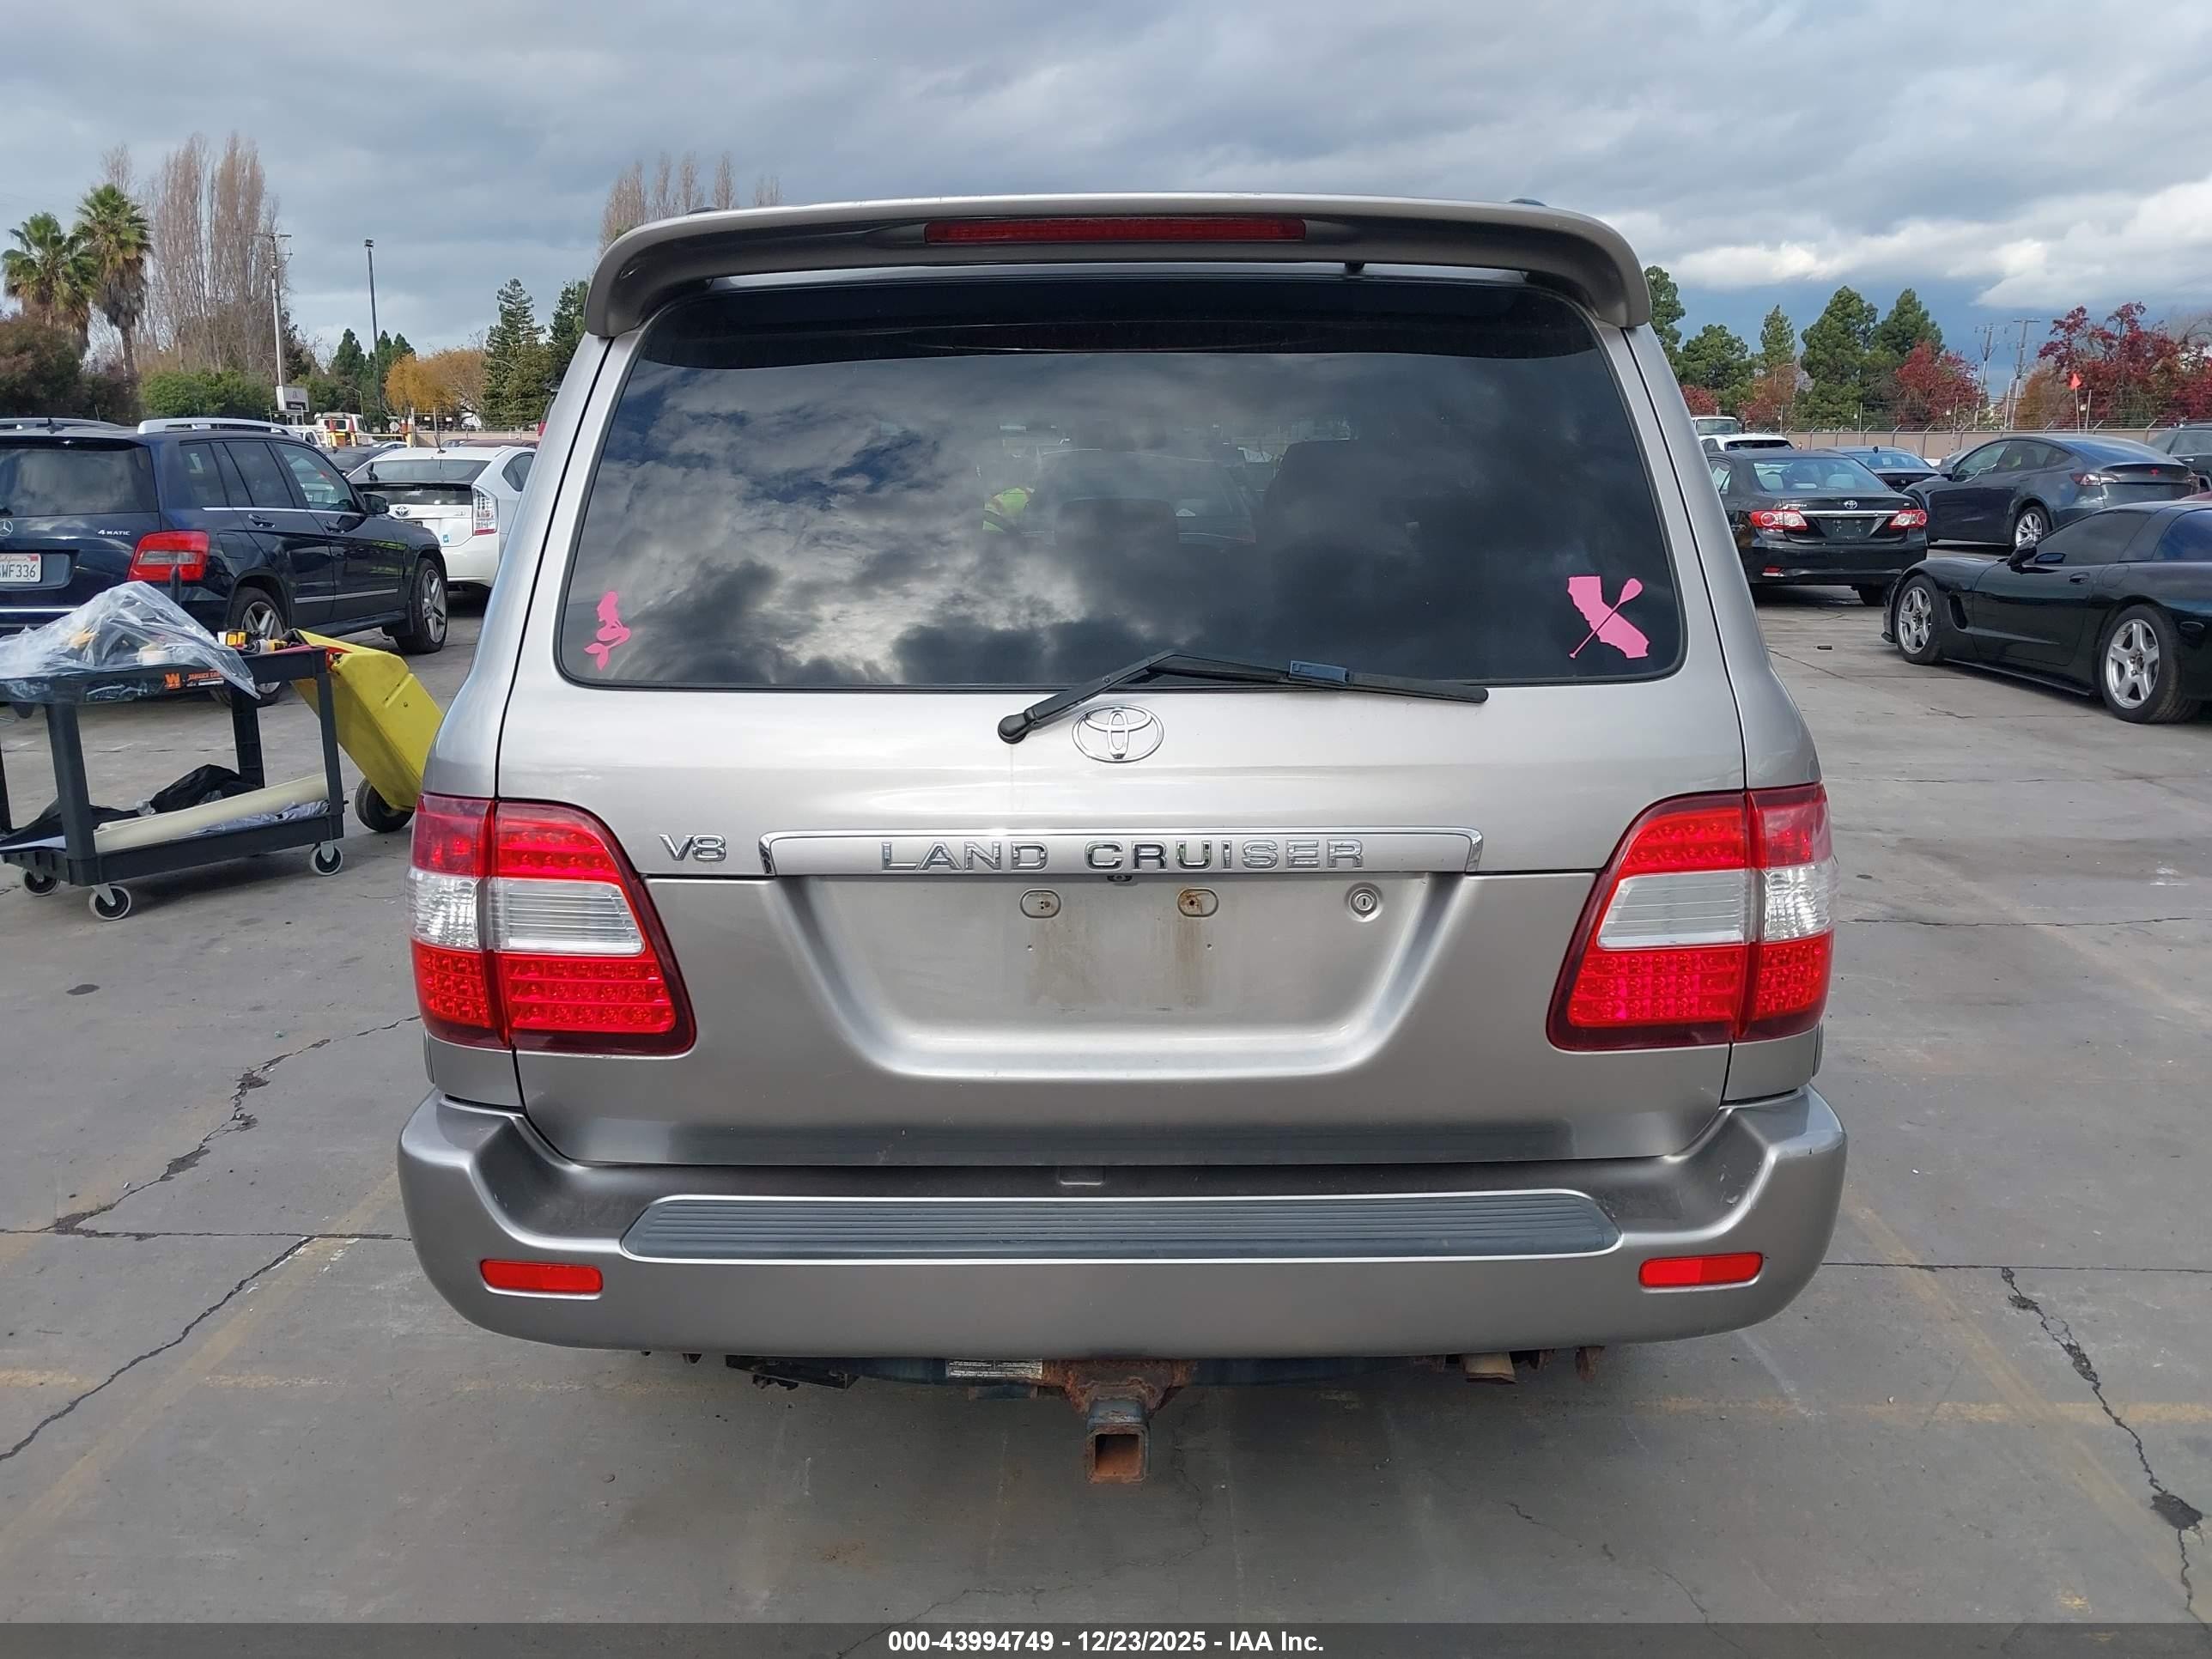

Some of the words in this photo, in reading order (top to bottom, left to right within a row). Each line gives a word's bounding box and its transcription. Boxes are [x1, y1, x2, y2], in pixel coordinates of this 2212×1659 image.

[659, 834, 727, 861] V8
[881, 840, 1049, 872] LAND
[1084, 838, 1365, 871] CRUISER
